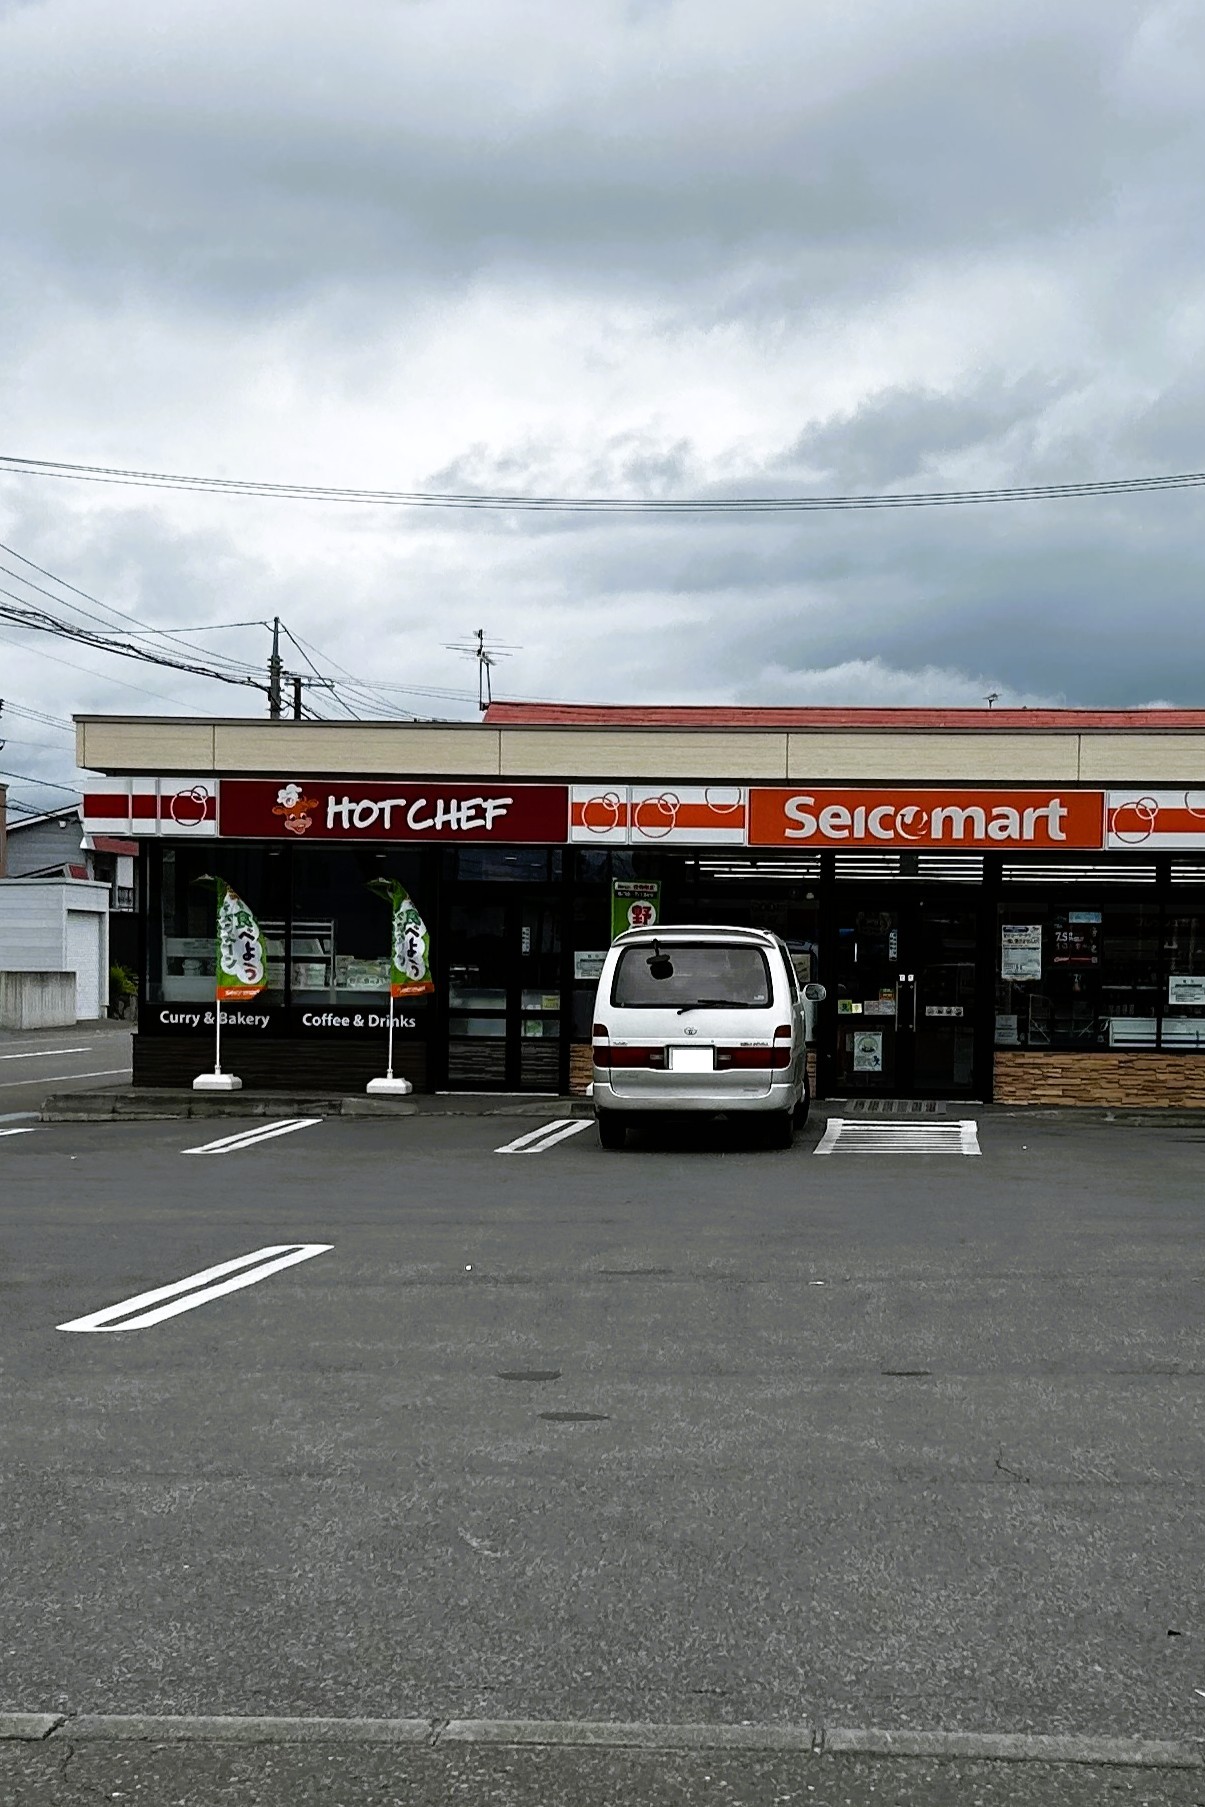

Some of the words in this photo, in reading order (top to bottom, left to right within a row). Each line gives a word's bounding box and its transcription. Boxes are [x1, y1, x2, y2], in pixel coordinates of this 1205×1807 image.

[327, 795, 406, 829] HOT
[407, 797, 514, 830] CHEF
[784, 796, 1068, 841] Seicomart
[159, 1010, 201, 1027] Curry
[203, 1012, 215, 1024] &
[218, 1012, 270, 1028] Bakery
[302, 1013, 350, 1026] Coffee
[352, 1014, 365, 1027] &
[368, 1014, 416, 1028] Drinks
